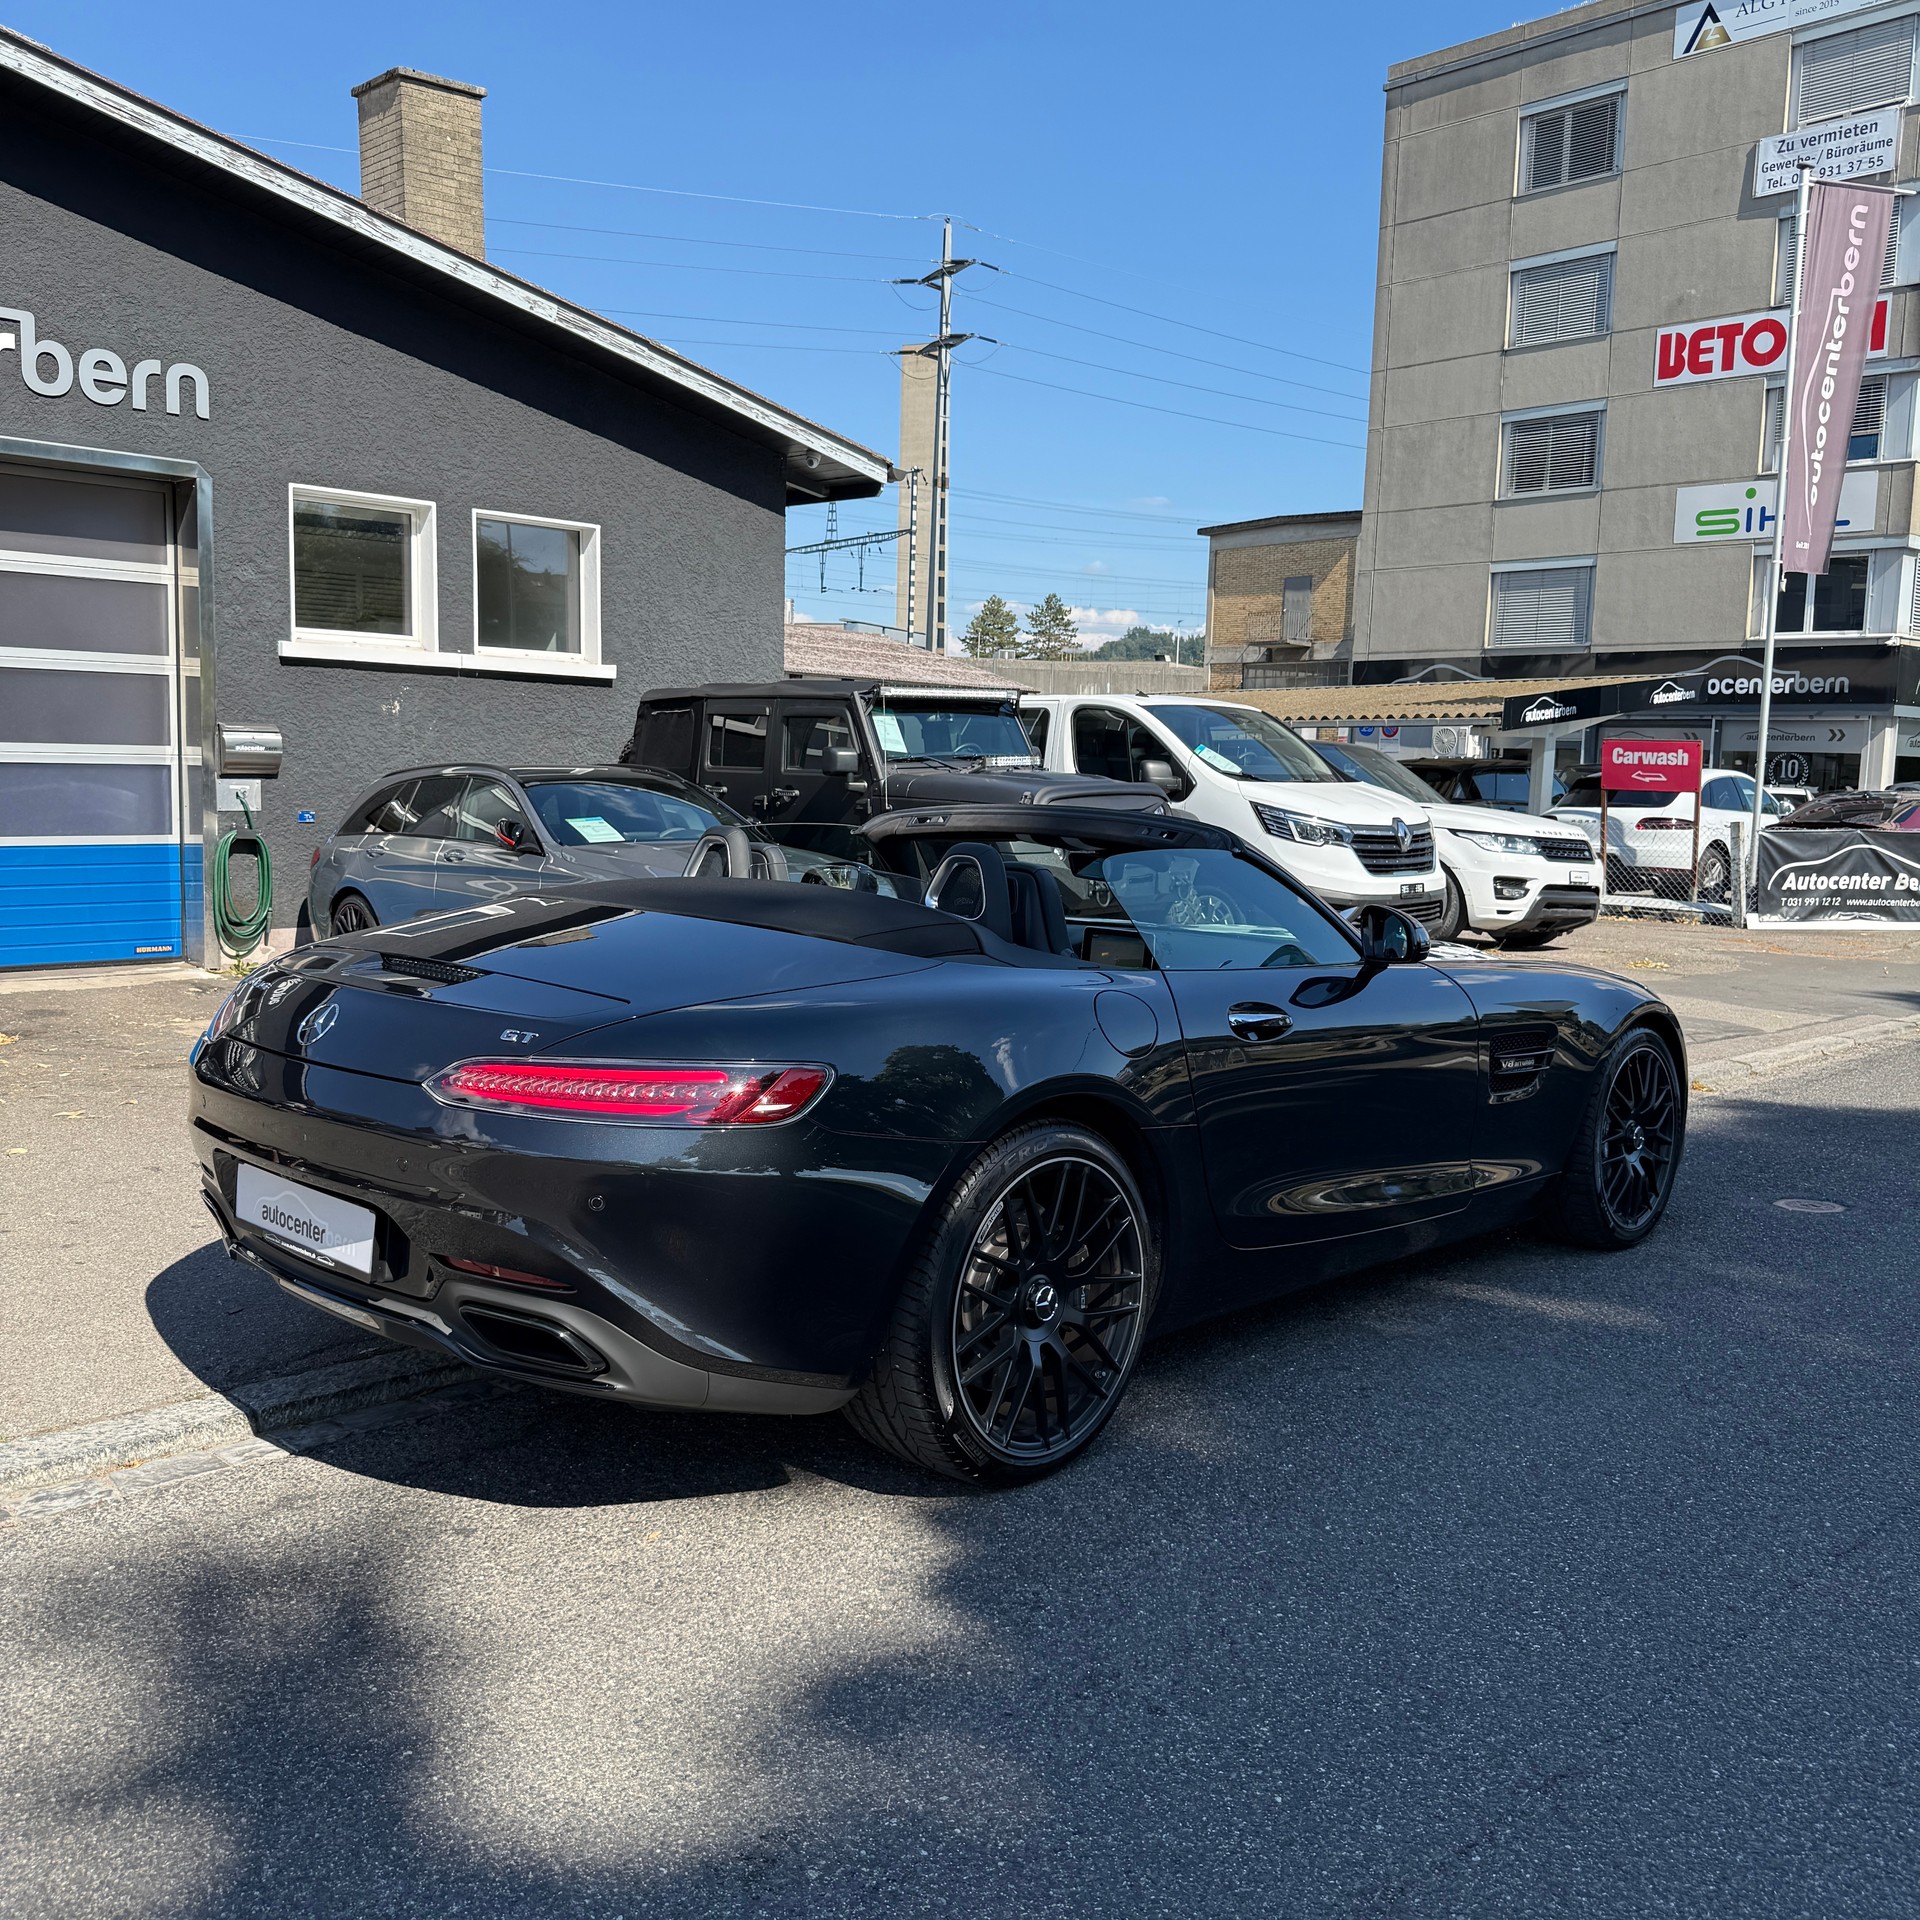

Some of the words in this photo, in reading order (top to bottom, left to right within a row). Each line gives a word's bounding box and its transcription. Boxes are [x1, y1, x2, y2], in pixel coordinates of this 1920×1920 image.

[1795, 5, 1817, 17] since
[1777, 139, 1795, 153] Zu
[1801, 121, 1878, 149] vermieten
[1767, 176, 1787, 189] Tel.
[1819, 164, 1842, 178] 931
[1847, 159, 1863, 173] 37
[1868, 155, 1884, 168] 55
[1612, 747, 1689, 766] Carwash
[1780, 759, 1799, 779] 10
[1781, 872, 1893, 891] Autocenter
[1894, 873, 1920, 891] Be
[1787, 898, 1802, 907] 031
[1804, 897, 1819, 906] 991
[500, 1029, 539, 1044] GT
